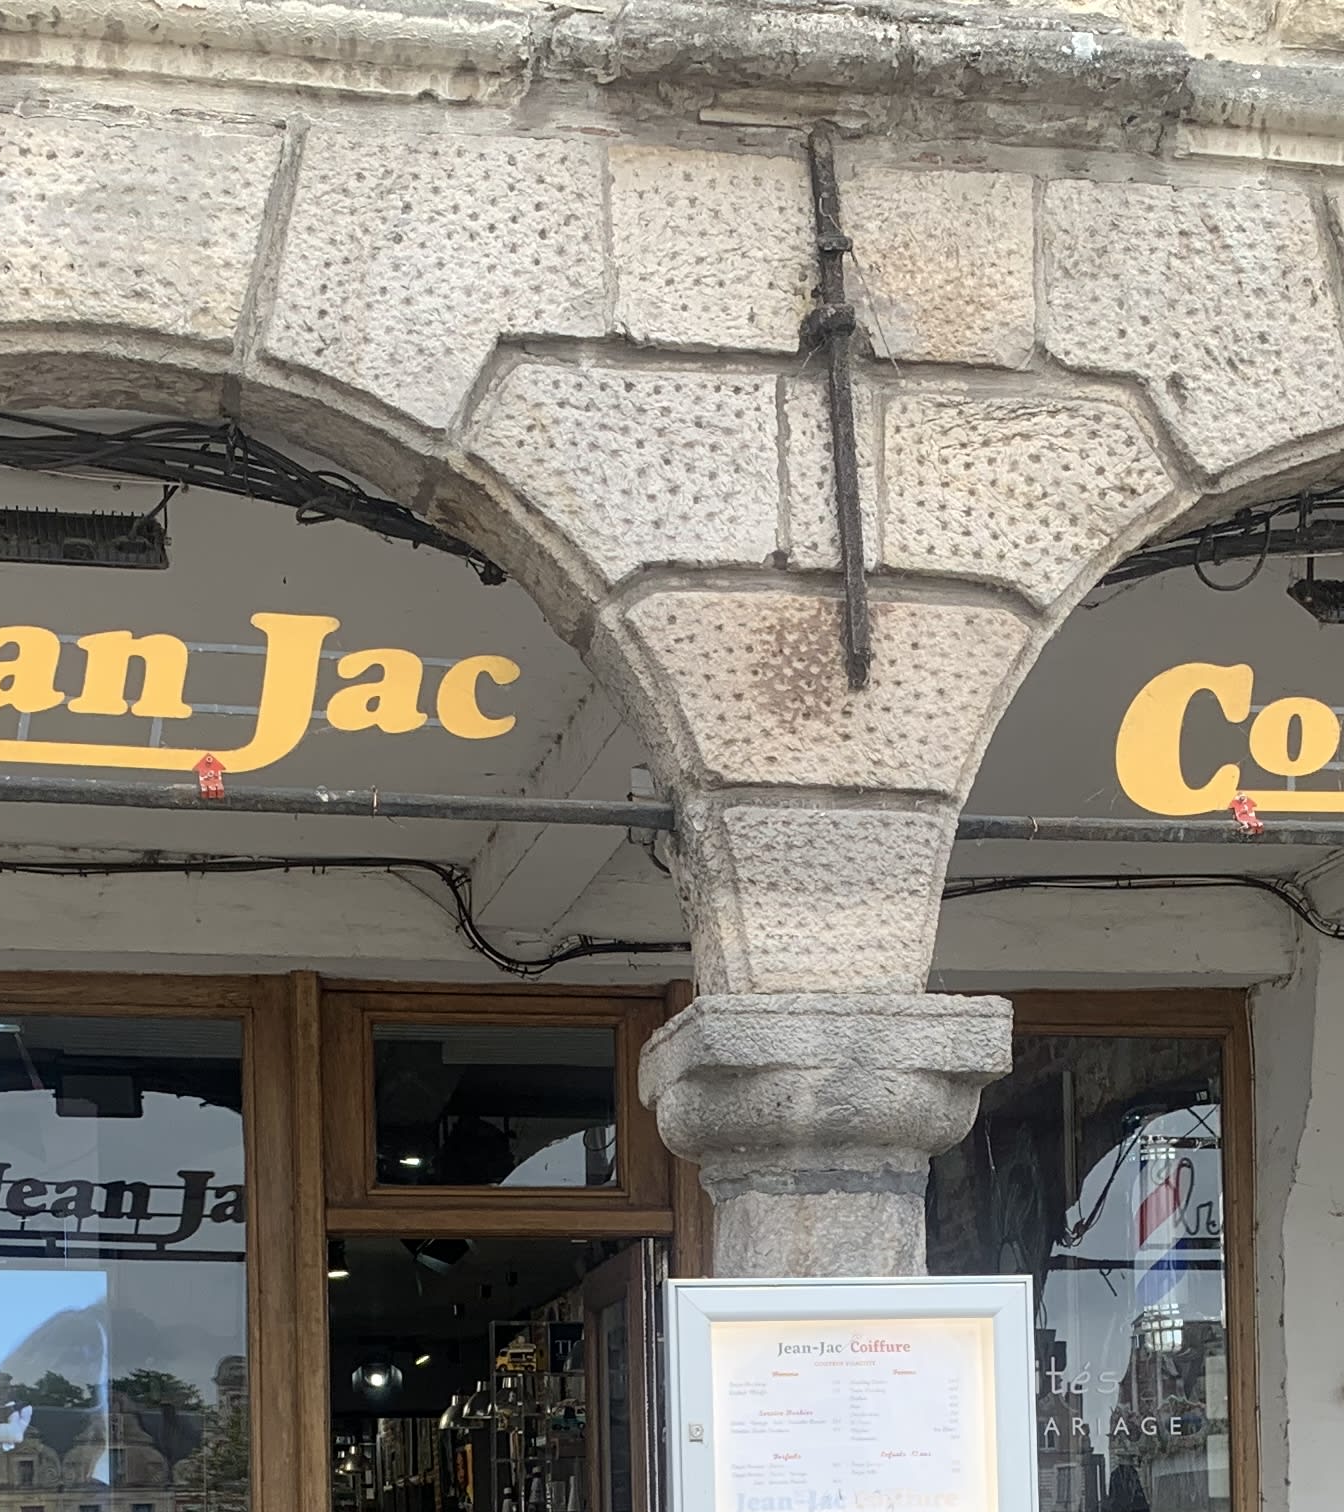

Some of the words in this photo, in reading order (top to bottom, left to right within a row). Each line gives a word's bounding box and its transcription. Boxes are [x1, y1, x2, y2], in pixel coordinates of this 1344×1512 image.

[248, 612, 522, 774] Jac
[177, 1170, 246, 1244] Ja
[777, 1341, 843, 1357] Jean-Jac
[850, 1339, 912, 1354] Coiffure
[1043, 1416, 1183, 1436] ARIAGE
